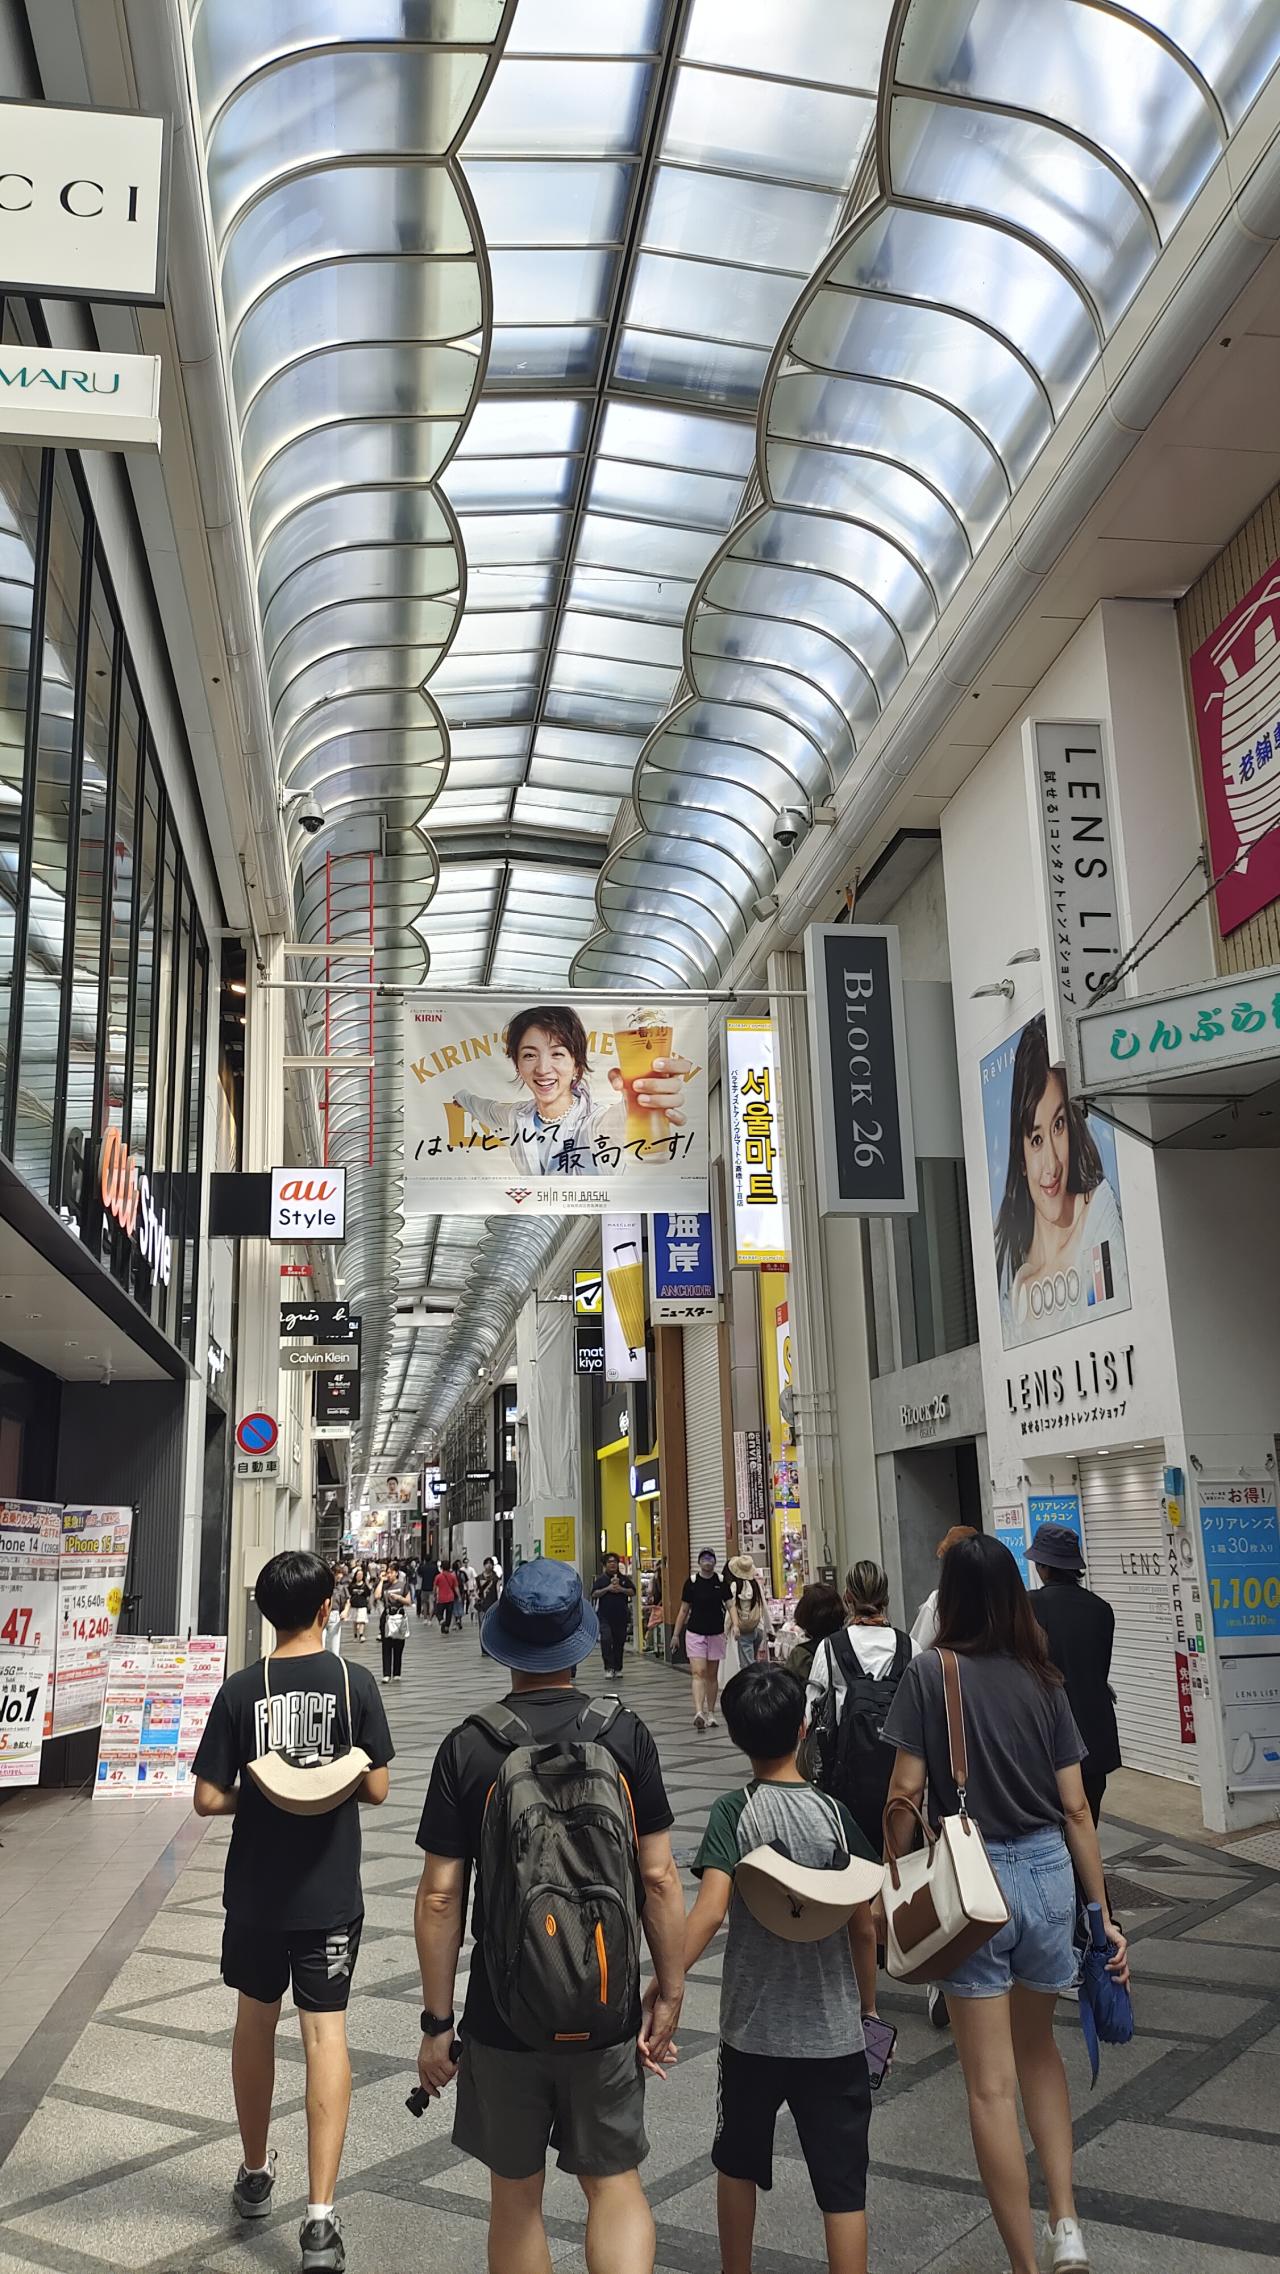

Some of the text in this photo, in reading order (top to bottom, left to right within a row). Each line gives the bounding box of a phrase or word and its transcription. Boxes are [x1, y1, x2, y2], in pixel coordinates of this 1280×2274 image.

[1065, 748, 1107, 878] LENS
[414, 1014, 443, 1022] KIRIN
[843, 968, 885, 1168] BLOCK 26
[741, 1067, 778, 1204] 서울마트
[552, 1132, 695, 1174] 最高です!
[279, 1180, 337, 1201] au
[279, 1208, 336, 1229] Style
[139, 1175, 171, 1287] Style
[661, 1285, 712, 1297] ANCHOR
[660, 1307, 713, 1317] ニュースター
[289, 1352, 350, 1364] Calvin Klein
[579, 1357, 602, 1372] kiyo
[1006, 1365, 1064, 1414] LENS
[238, 1461, 278, 1473] 自動車
[1227, 1487, 1266, 1504] お得!
[1030, 1501, 1077, 1513] クリアレンズ
[1203, 1517, 1275, 1530] クリアレンズ
[29, 1538, 38, 1552] 14
[65, 1535, 99, 1553] iPhone
[1120, 1552, 1161, 1576] LENS
[1166, 1533, 1186, 1643] TAX FREE
[254, 1690, 336, 1760] FORCE
